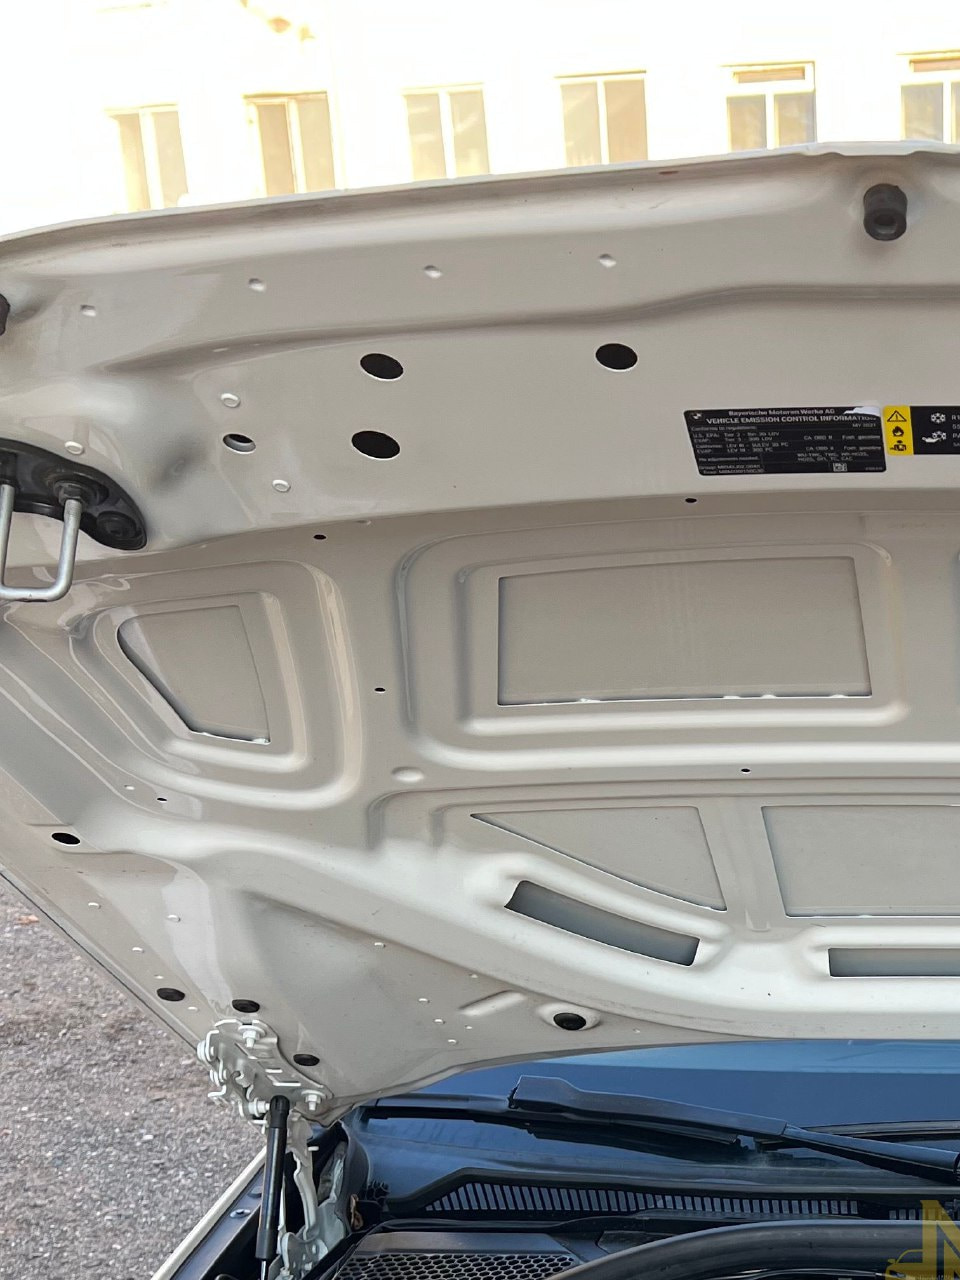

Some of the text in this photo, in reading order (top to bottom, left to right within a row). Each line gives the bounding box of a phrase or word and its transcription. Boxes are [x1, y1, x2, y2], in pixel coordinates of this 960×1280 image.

[768, 409, 800, 417] Motoren
[741, 416, 780, 424] EMISSION
[781, 415, 819, 423] CONTROL
